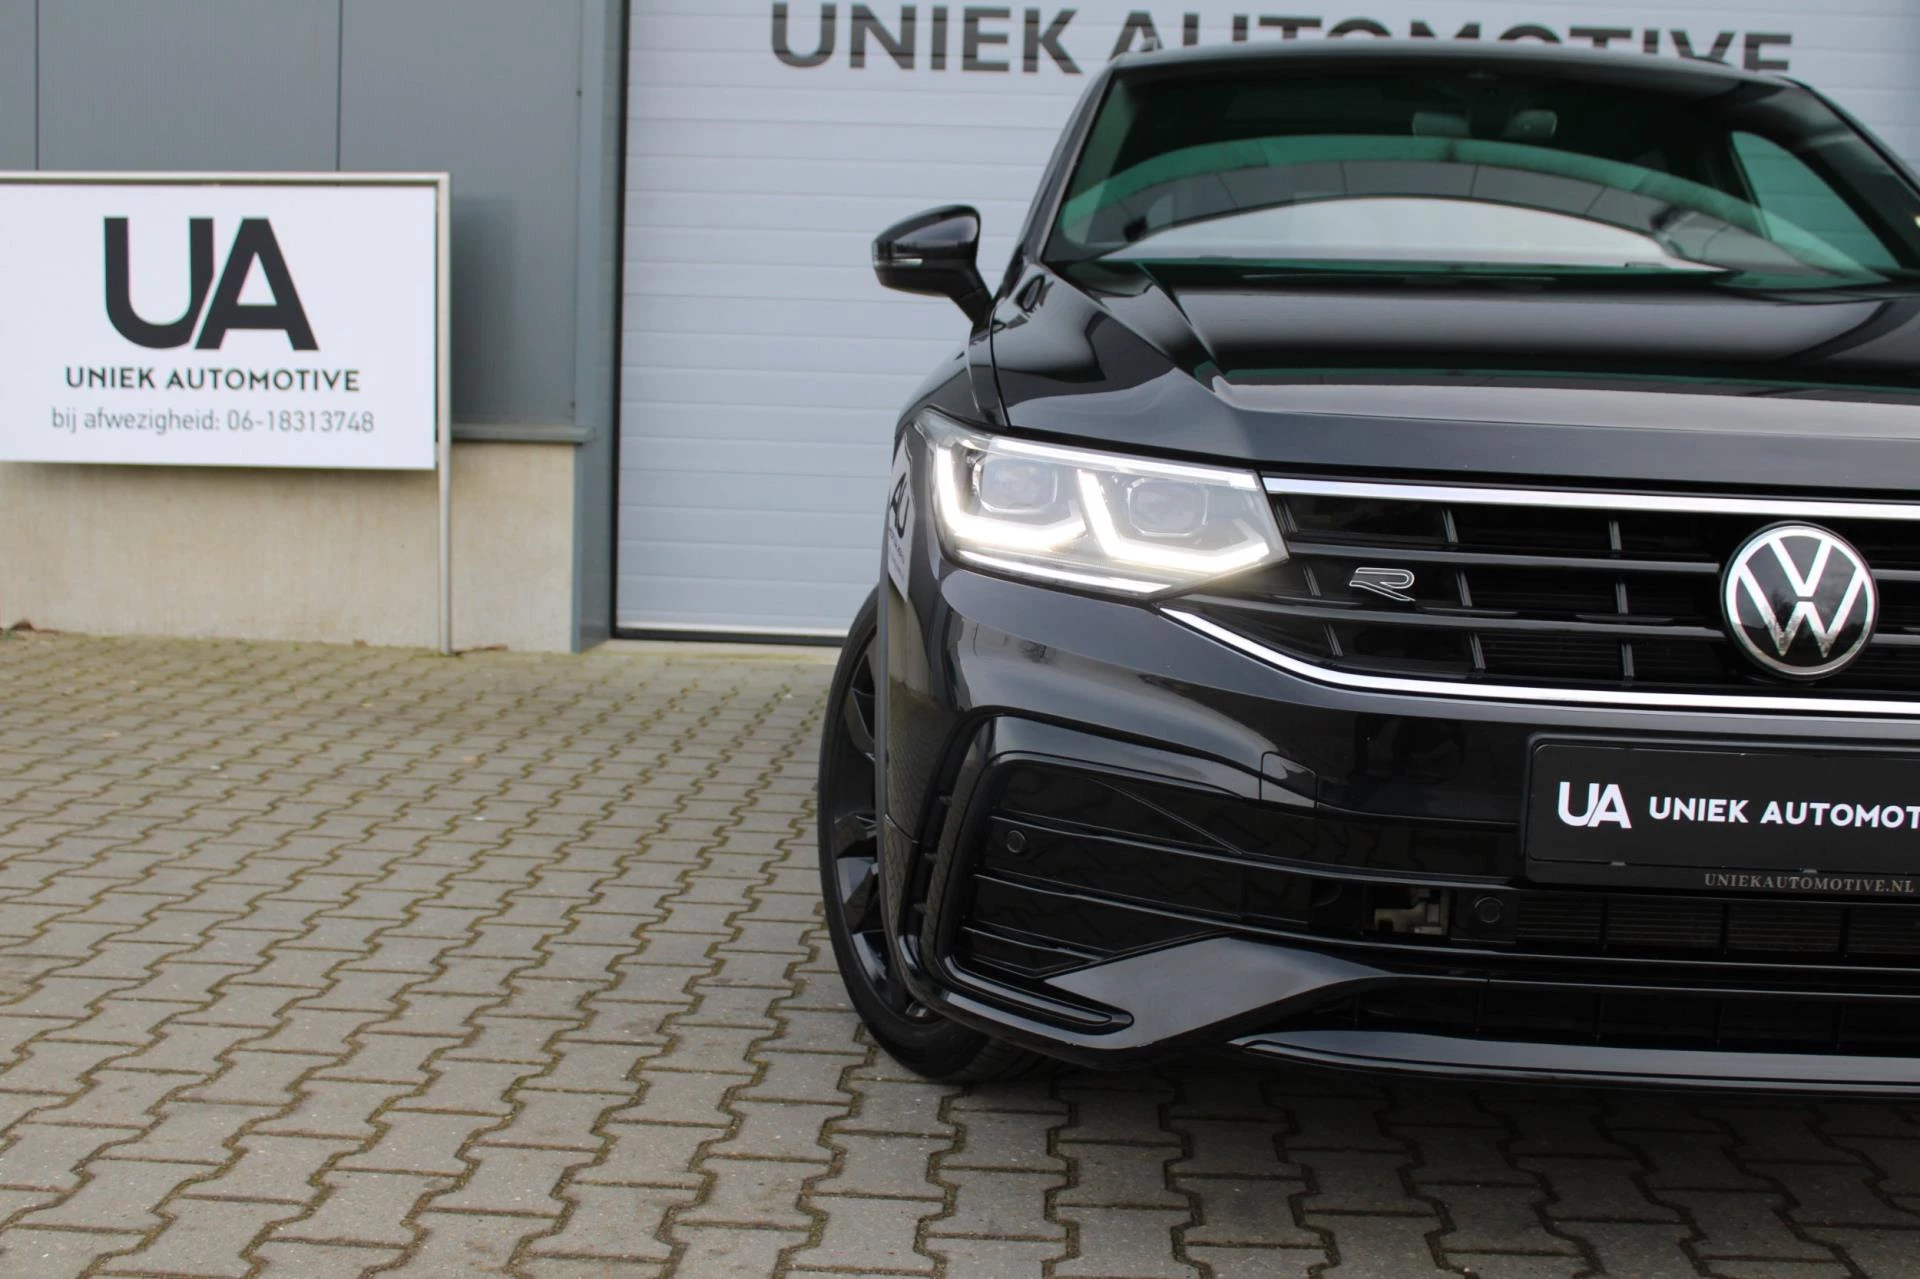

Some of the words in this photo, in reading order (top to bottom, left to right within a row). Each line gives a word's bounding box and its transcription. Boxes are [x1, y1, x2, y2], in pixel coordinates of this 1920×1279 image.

[771, 3, 1083, 75] UNIEK
[103, 216, 320, 351] UA
[65, 366, 156, 389] UNIEK
[166, 368, 361, 391] AUTOMOTIVE
[51, 407, 78, 432] bij
[83, 408, 220, 434] afwezigheid:
[227, 409, 375, 432] 06-18313748
[1557, 781, 1632, 829] UA
[1649, 796, 1749, 825] UNIEK
[1759, 800, 1920, 830] AUTOMOT
[1704, 873, 1914, 894] UNIEKAUTOMOTIVE.NL
